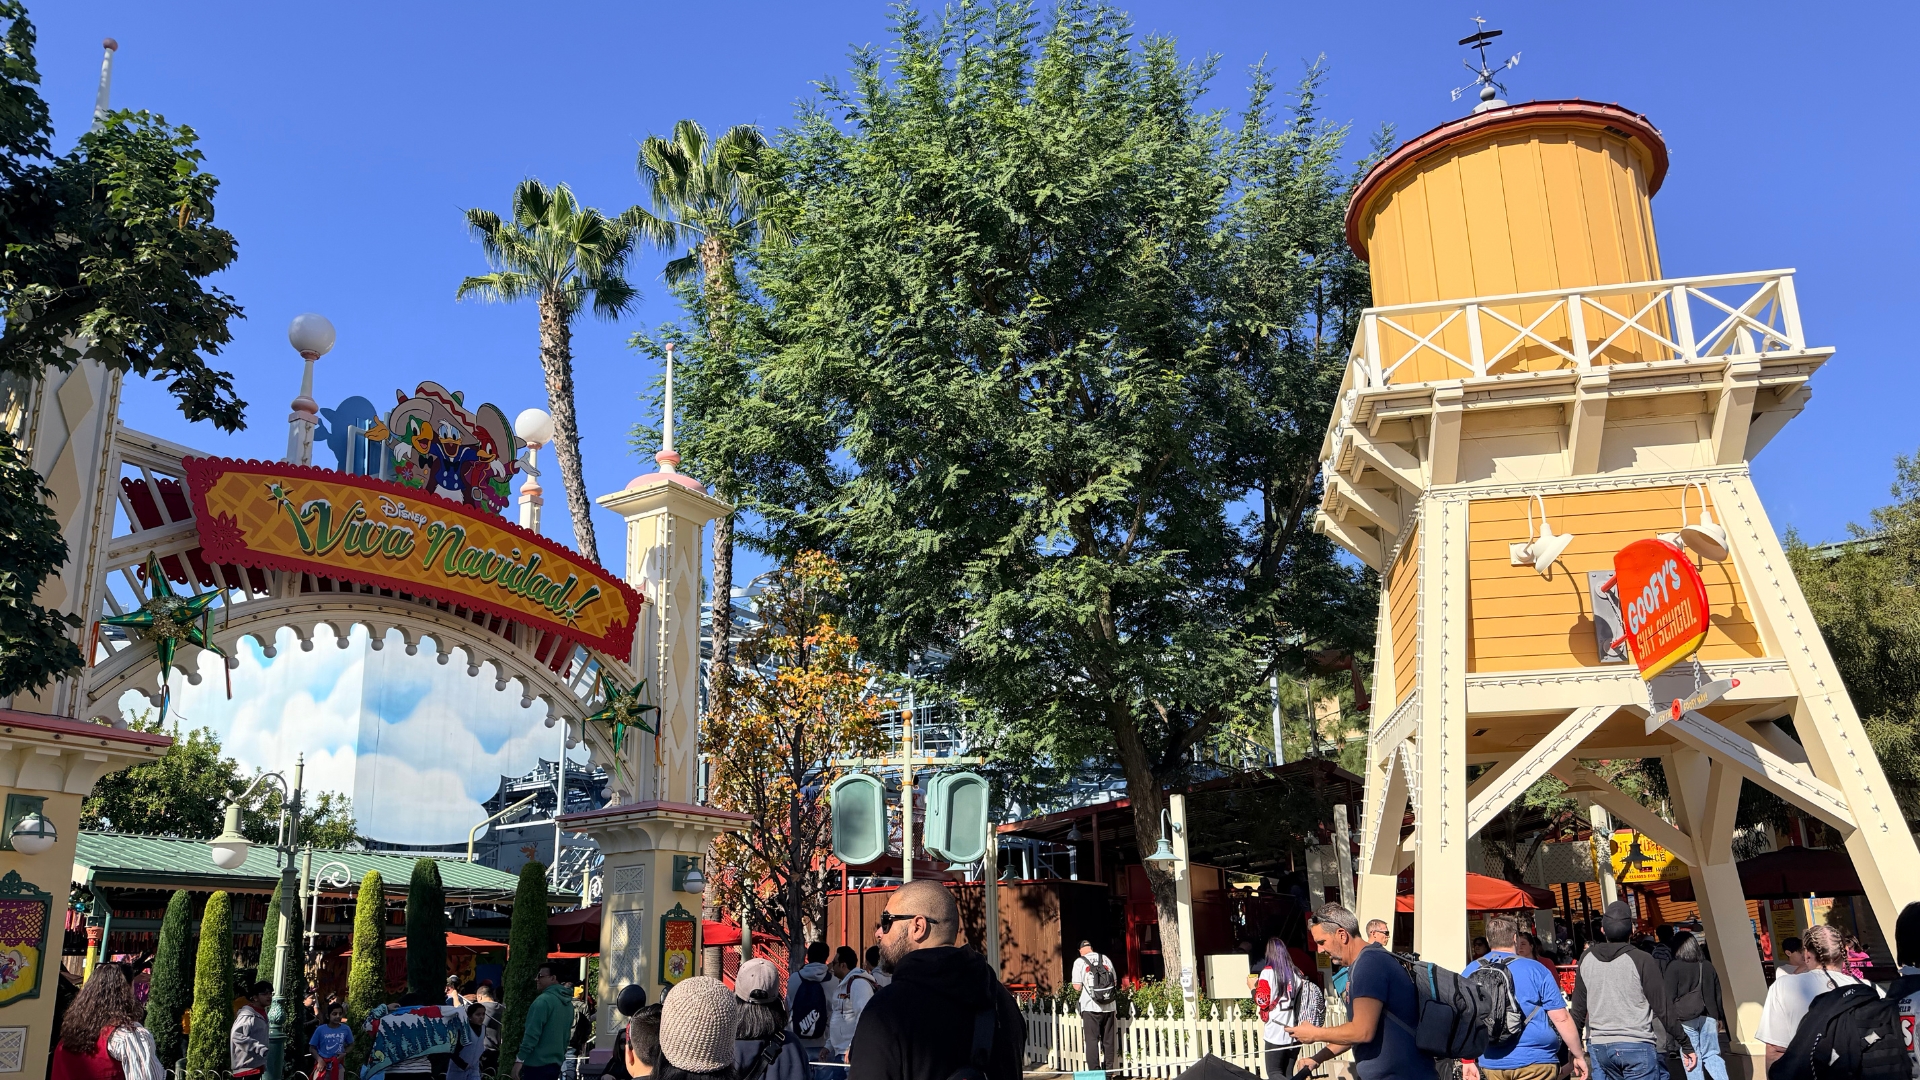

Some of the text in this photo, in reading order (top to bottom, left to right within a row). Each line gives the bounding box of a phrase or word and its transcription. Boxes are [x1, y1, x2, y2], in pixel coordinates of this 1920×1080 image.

[379, 496, 428, 529] Disney
[1627, 559, 1681, 636] GOOFY'S
[1636, 597, 1698, 661] SKY SCHOOL
[799, 1009, 820, 1033] NIKE
